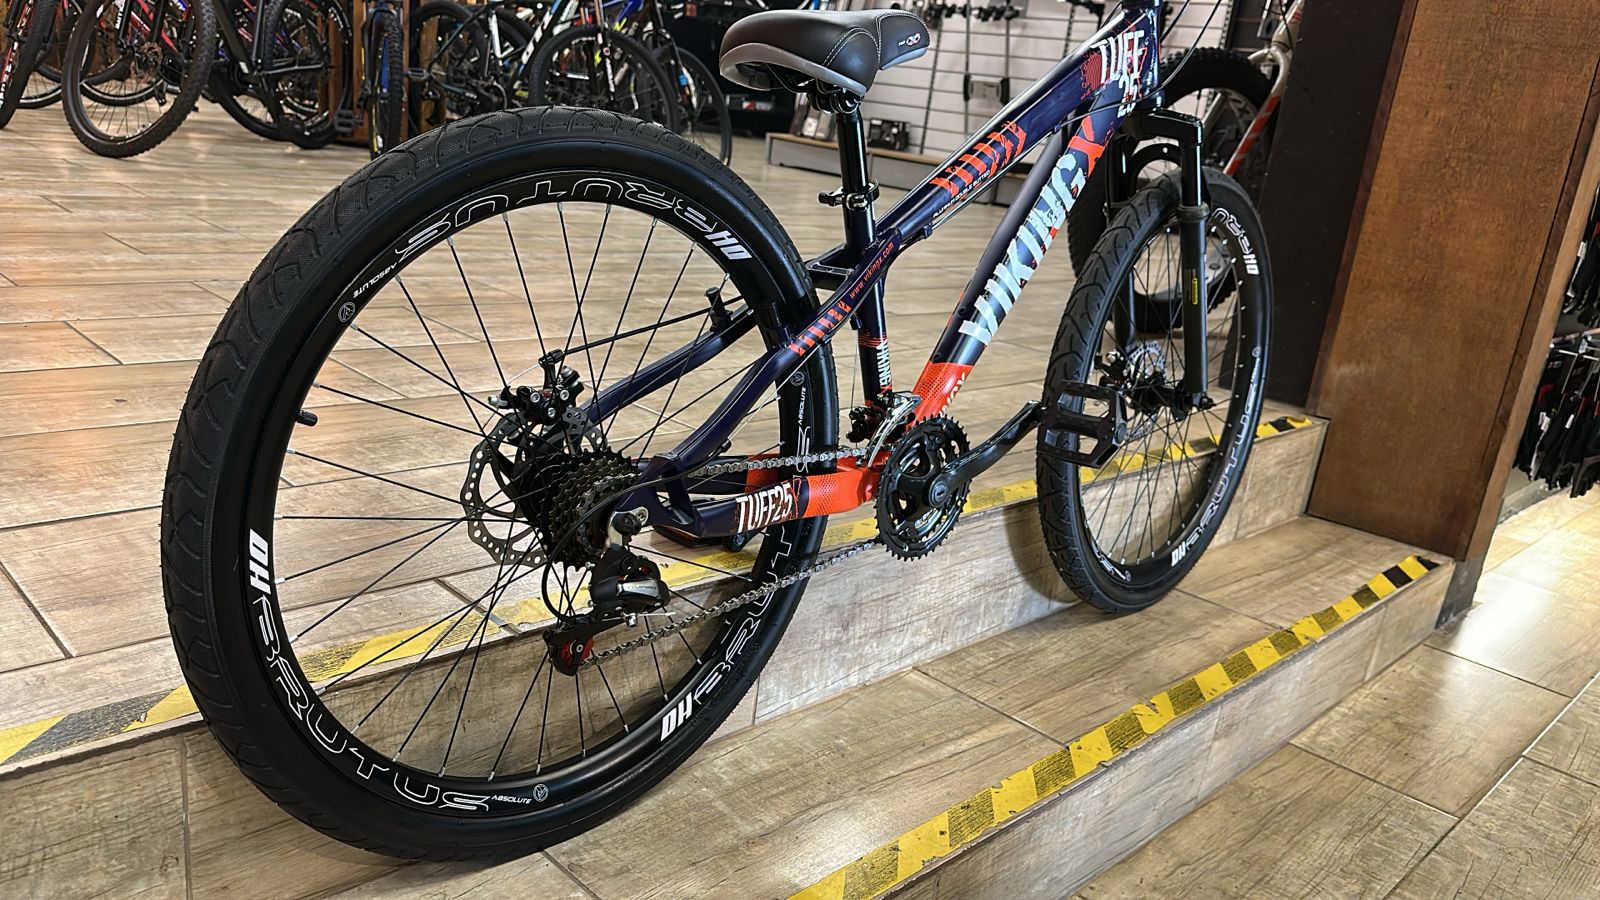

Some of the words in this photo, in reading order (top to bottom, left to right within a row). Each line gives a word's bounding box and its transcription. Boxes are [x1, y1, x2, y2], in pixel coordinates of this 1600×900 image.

[1089, 29, 1145, 84] TUFF
[394, 178, 720, 263] BRUTUS
[704, 229, 753, 260] DH
[352, 261, 399, 299] ABSOLUTE
[849, 242, 895, 299] www.vikingx.com
[1242, 253, 1260, 275] DH
[249, 528, 272, 595] DH
[660, 692, 694, 742] DH
[693, 425, 811, 705] BRUTS
[797, 386, 807, 426] ABSOLUTE
[1171, 541, 1187, 567] DH
[252, 594, 490, 812] BRUTUS
[491, 794, 533, 804] ABSOLUTE
